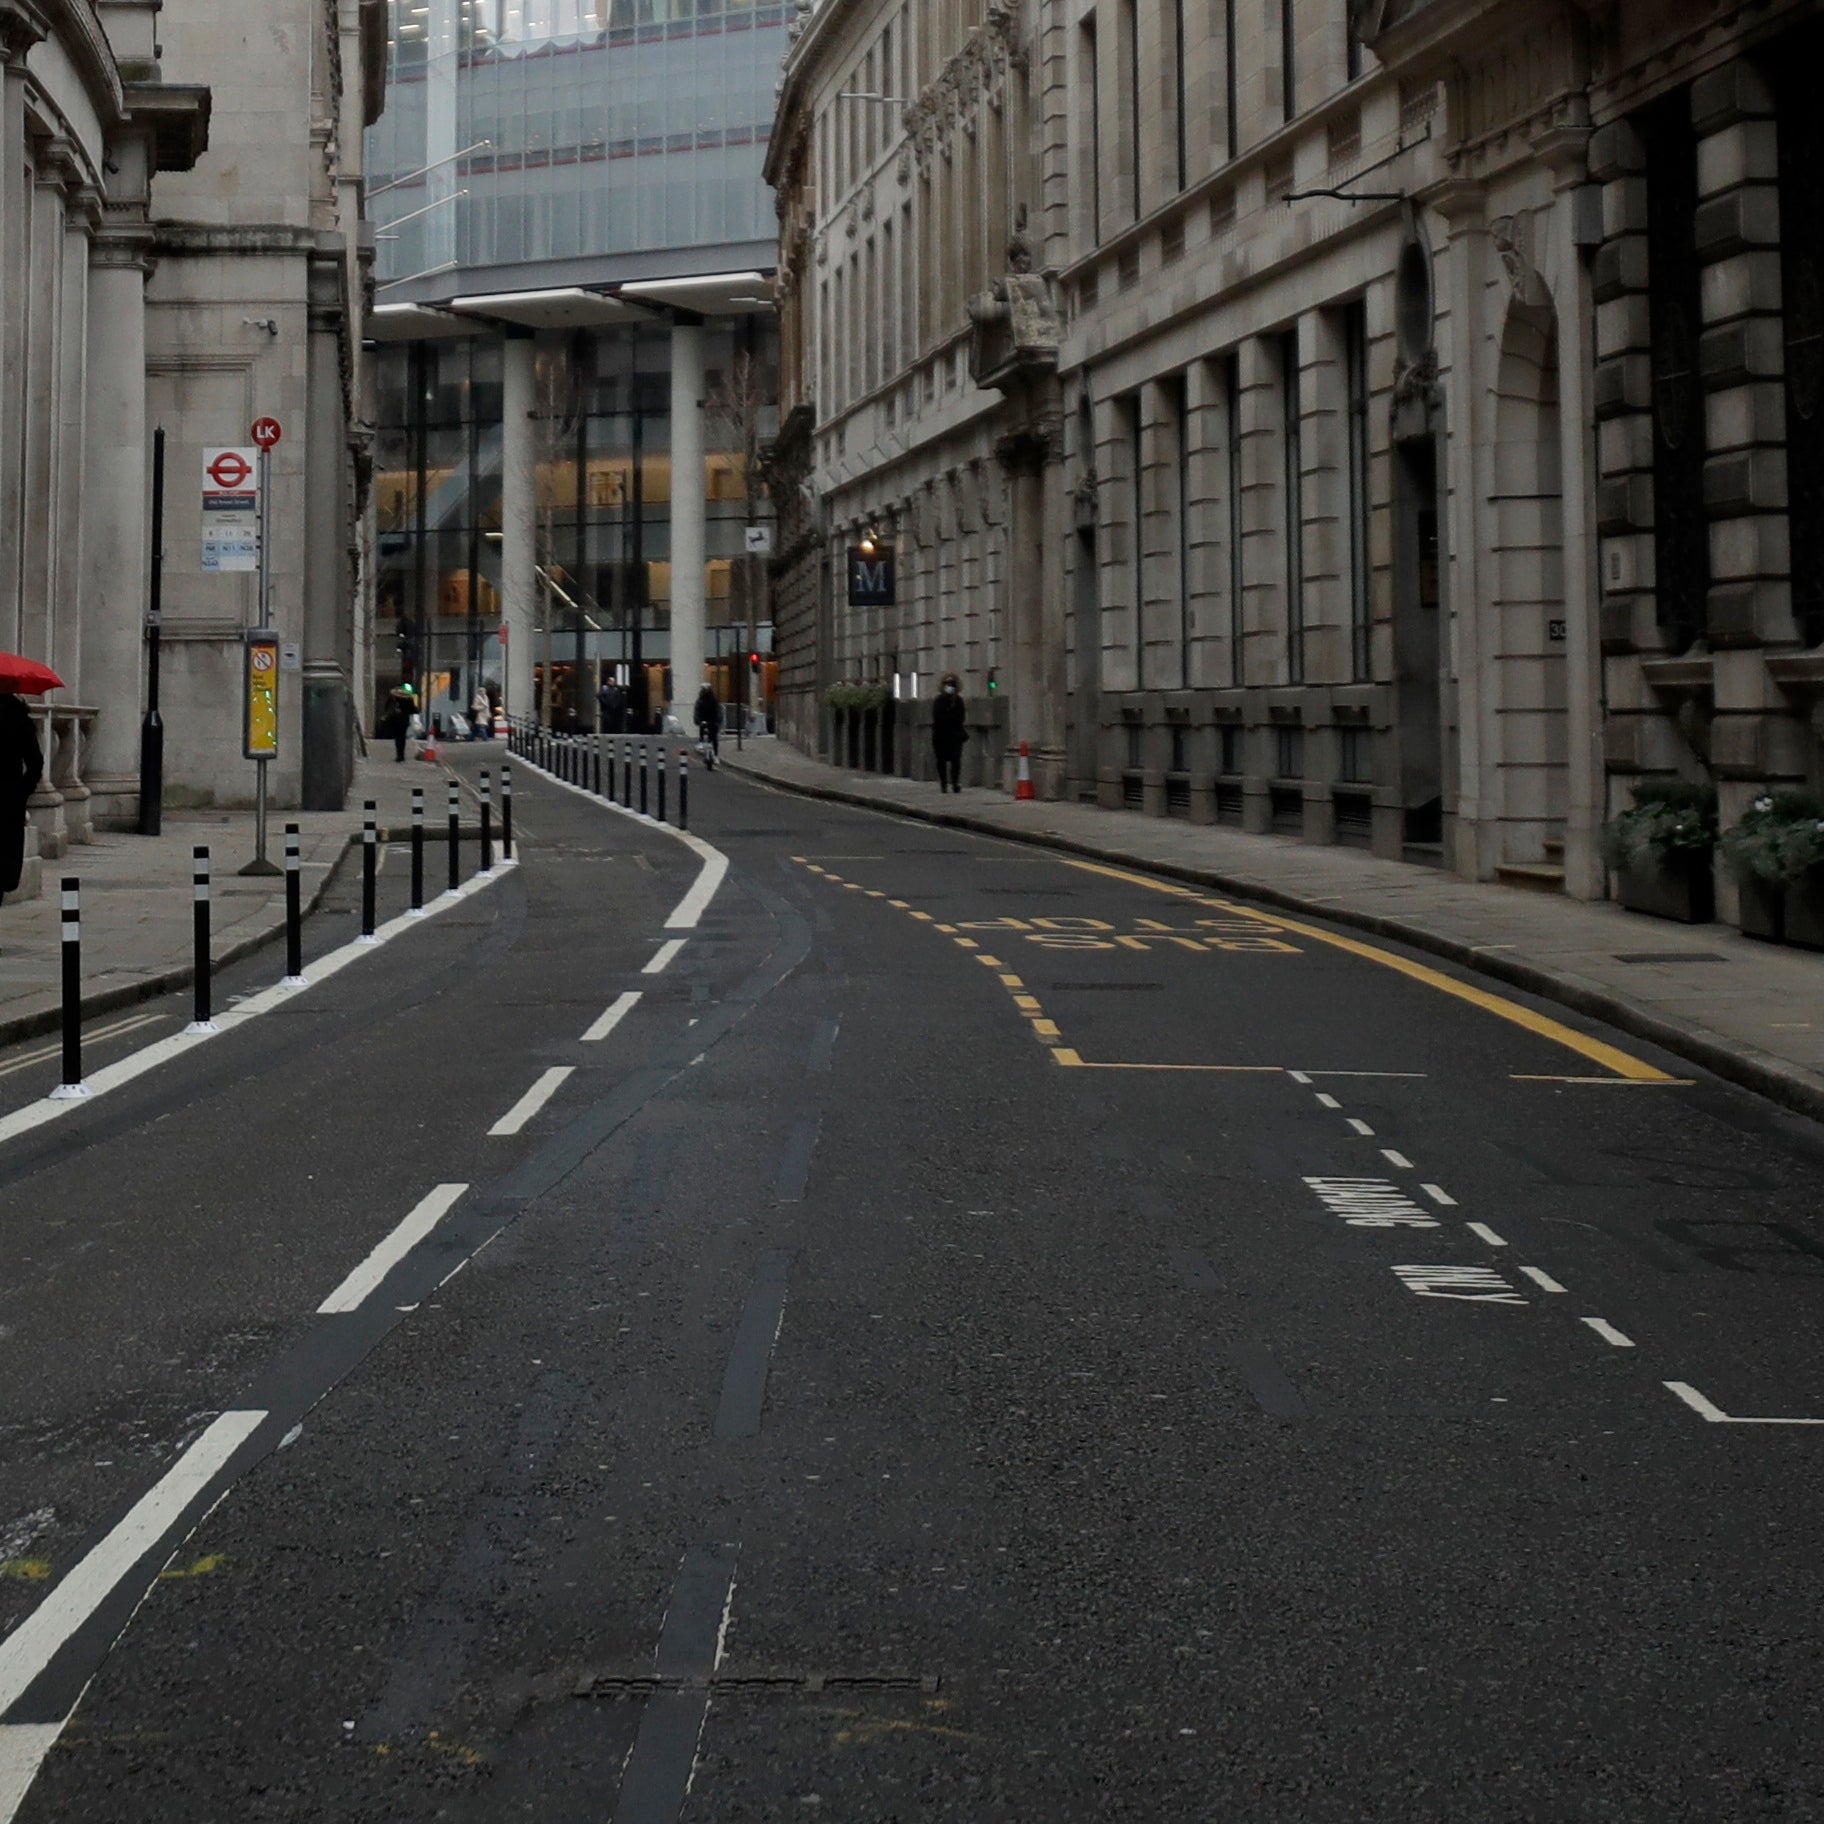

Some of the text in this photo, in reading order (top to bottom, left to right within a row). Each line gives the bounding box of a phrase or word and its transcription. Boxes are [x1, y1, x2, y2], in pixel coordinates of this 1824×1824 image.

[255, 425, 277, 439] LK
[855, 560, 888, 593] M
[954, 916, 1286, 934] STOP
[1024, 933, 1306, 954] BUS
[1300, 1176, 1531, 1306] LOADING ONLY
